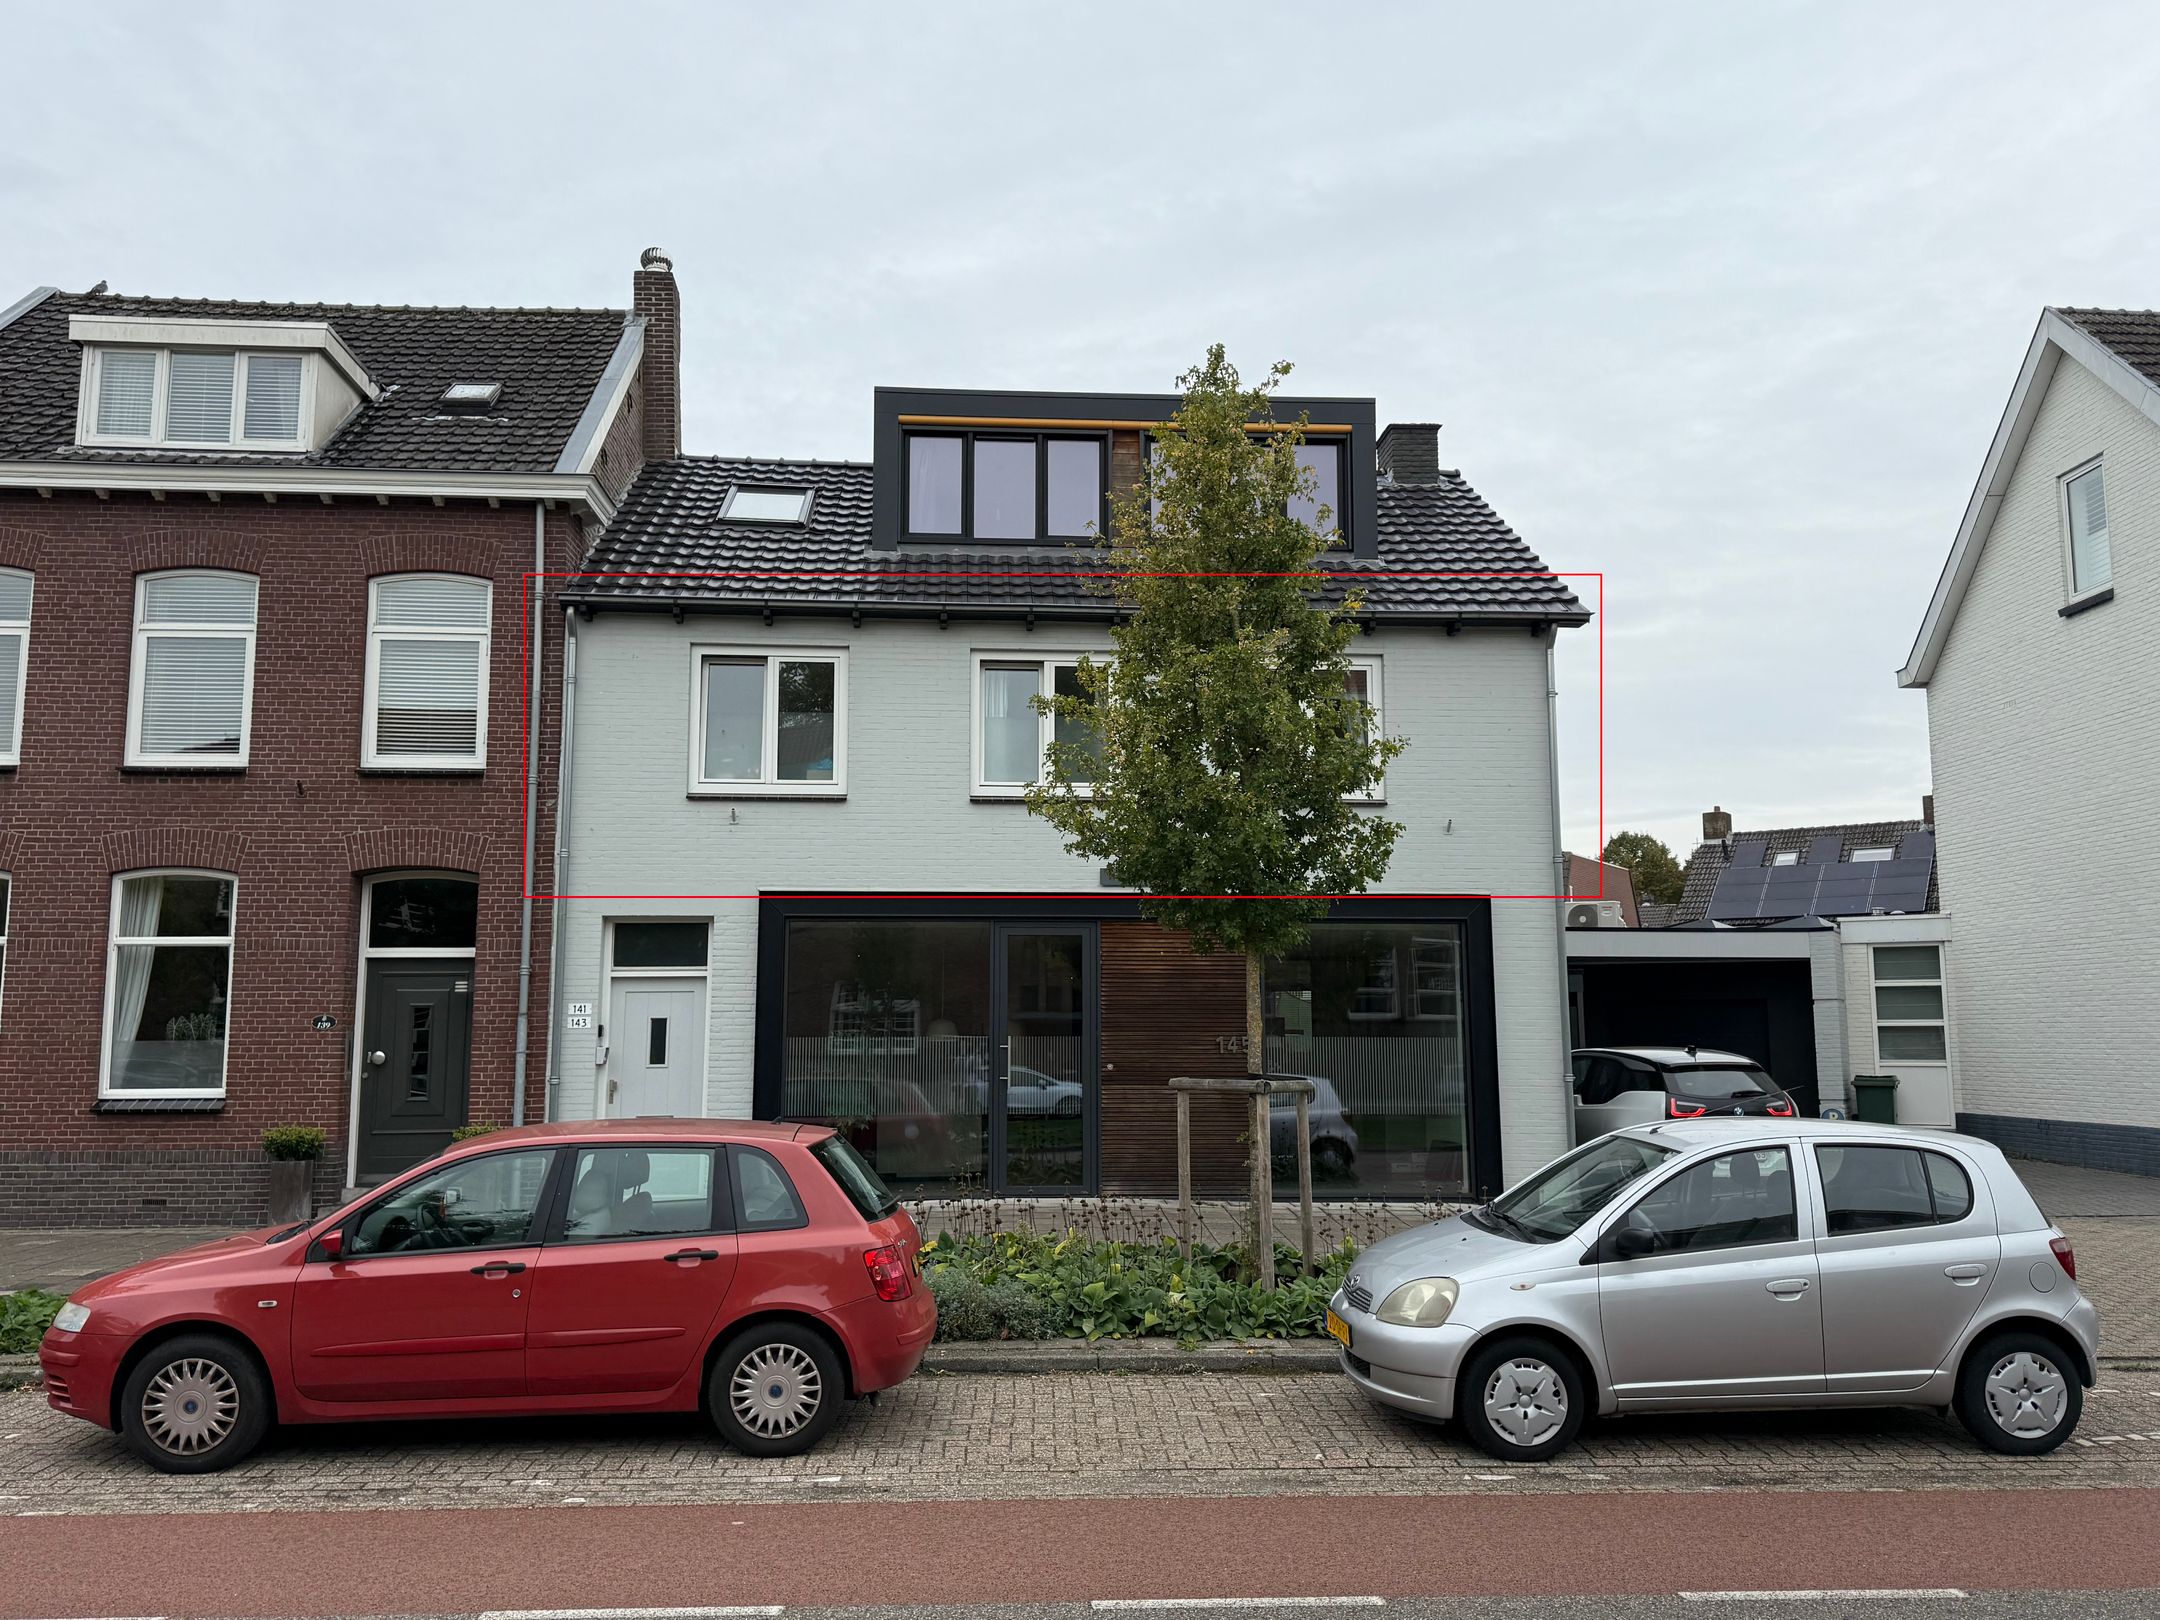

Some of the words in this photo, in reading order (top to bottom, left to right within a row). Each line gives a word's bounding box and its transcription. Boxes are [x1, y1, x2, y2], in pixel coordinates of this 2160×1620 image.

[573, 1005, 587, 1013] 141
[317, 1021, 331, 1029] 139
[571, 1018, 587, 1027] 143
